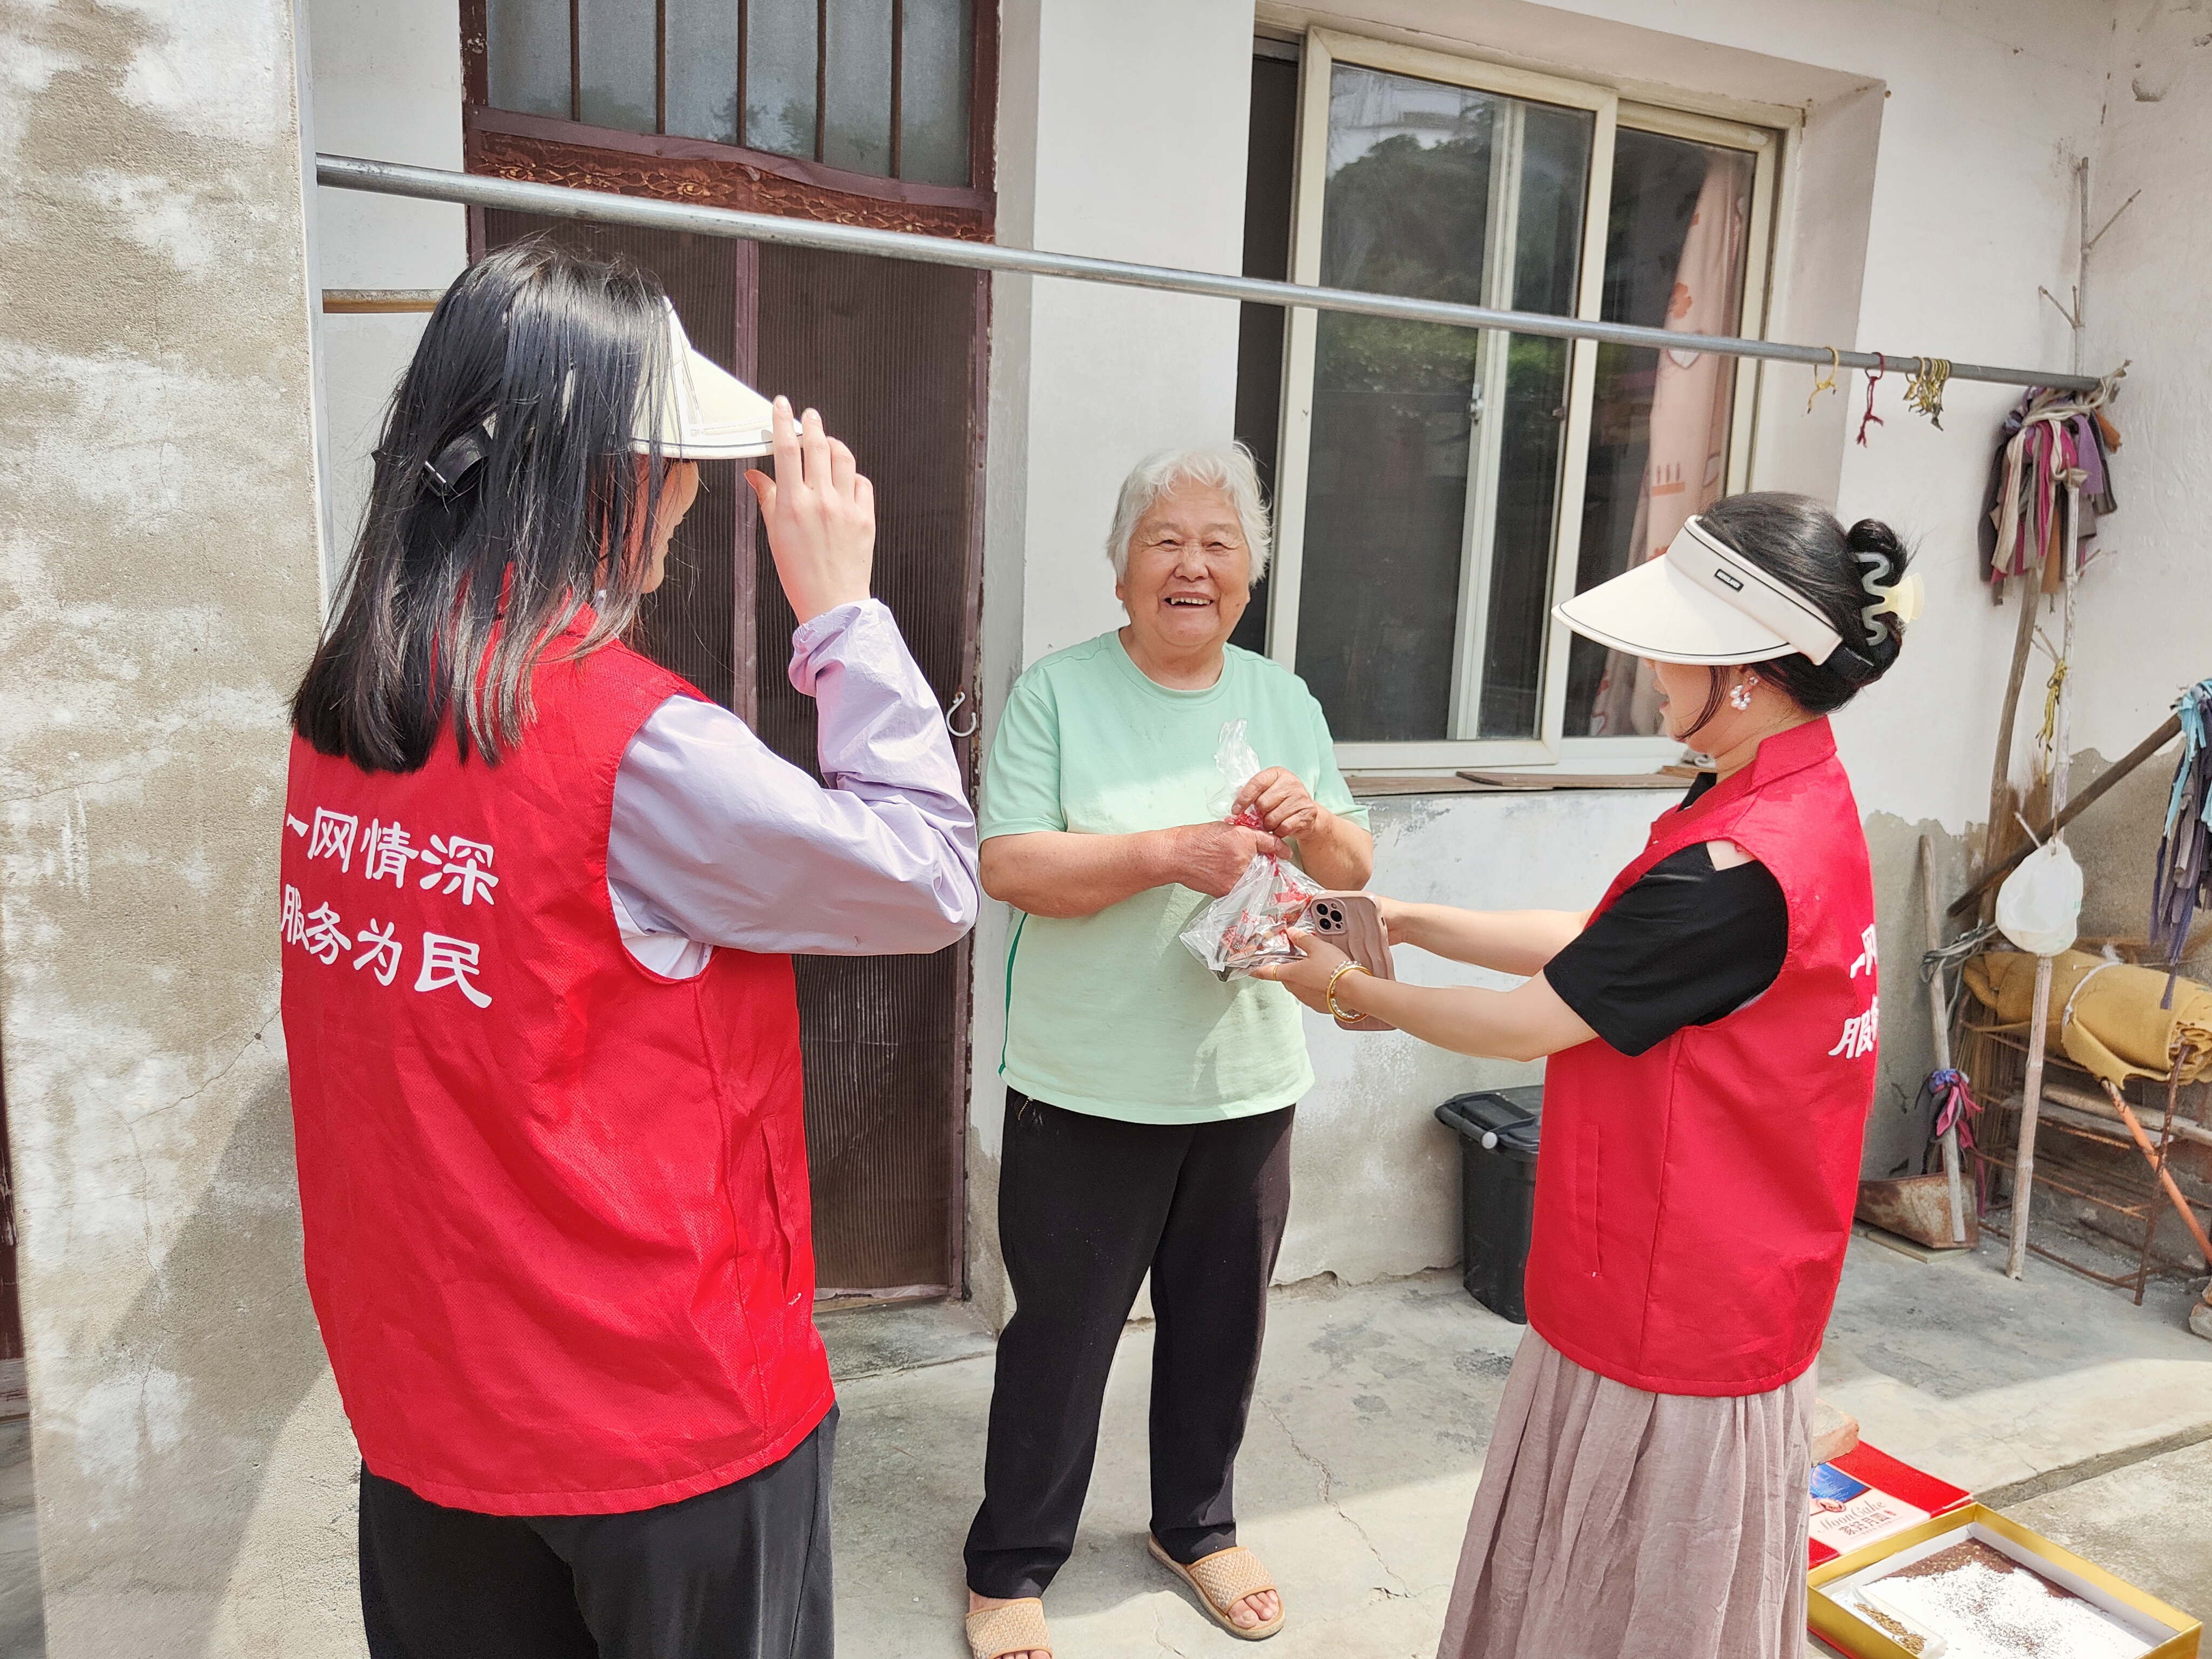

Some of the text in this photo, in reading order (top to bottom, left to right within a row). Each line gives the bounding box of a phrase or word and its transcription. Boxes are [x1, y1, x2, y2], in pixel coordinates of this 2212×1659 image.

[286, 806, 500, 905] 一网情深
[281, 884, 493, 1009] 服务为民
